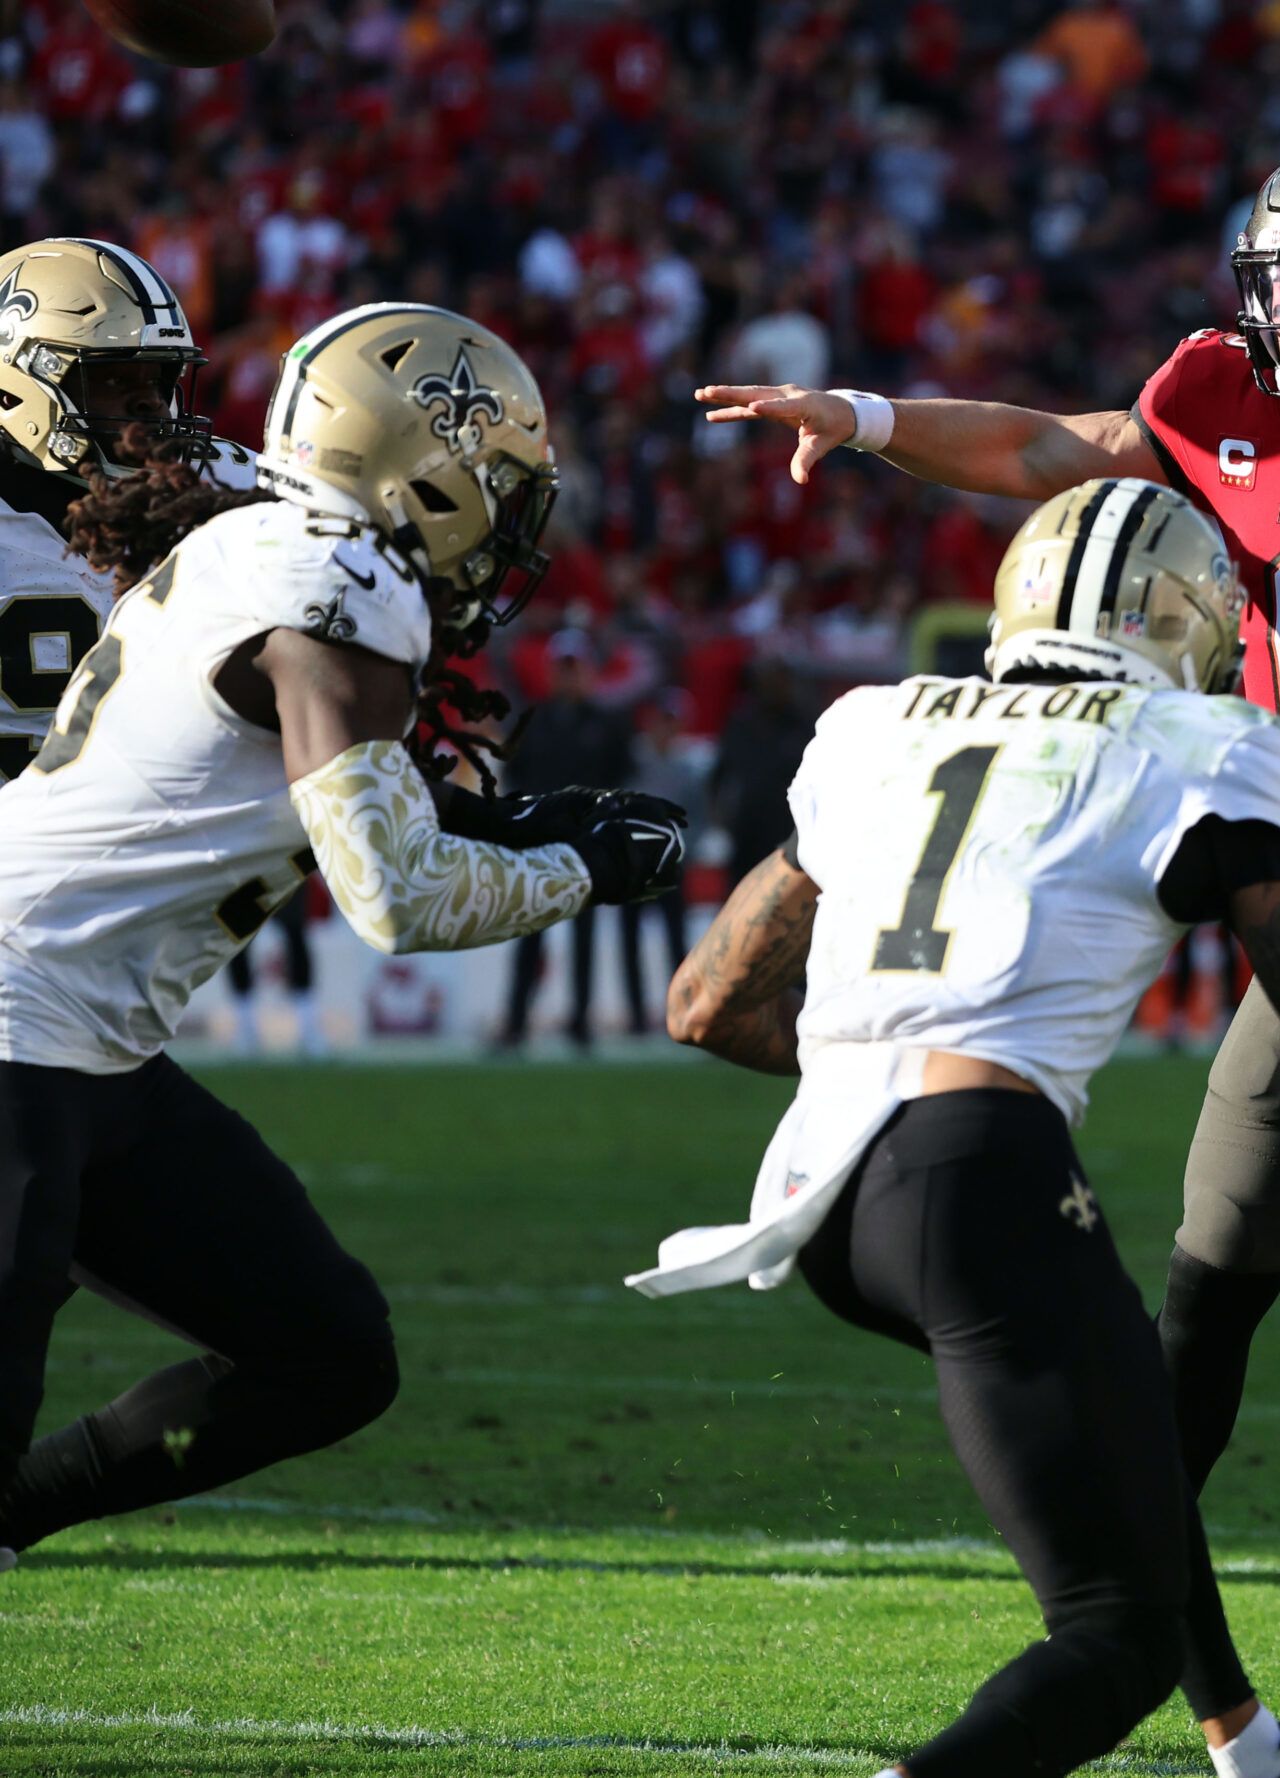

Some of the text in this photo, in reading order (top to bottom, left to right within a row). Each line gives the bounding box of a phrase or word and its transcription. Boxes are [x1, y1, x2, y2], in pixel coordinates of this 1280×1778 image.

[1219, 438, 1255, 477] C
[901, 682, 1123, 725] TAYLOR
[868, 742, 1004, 978] 1
